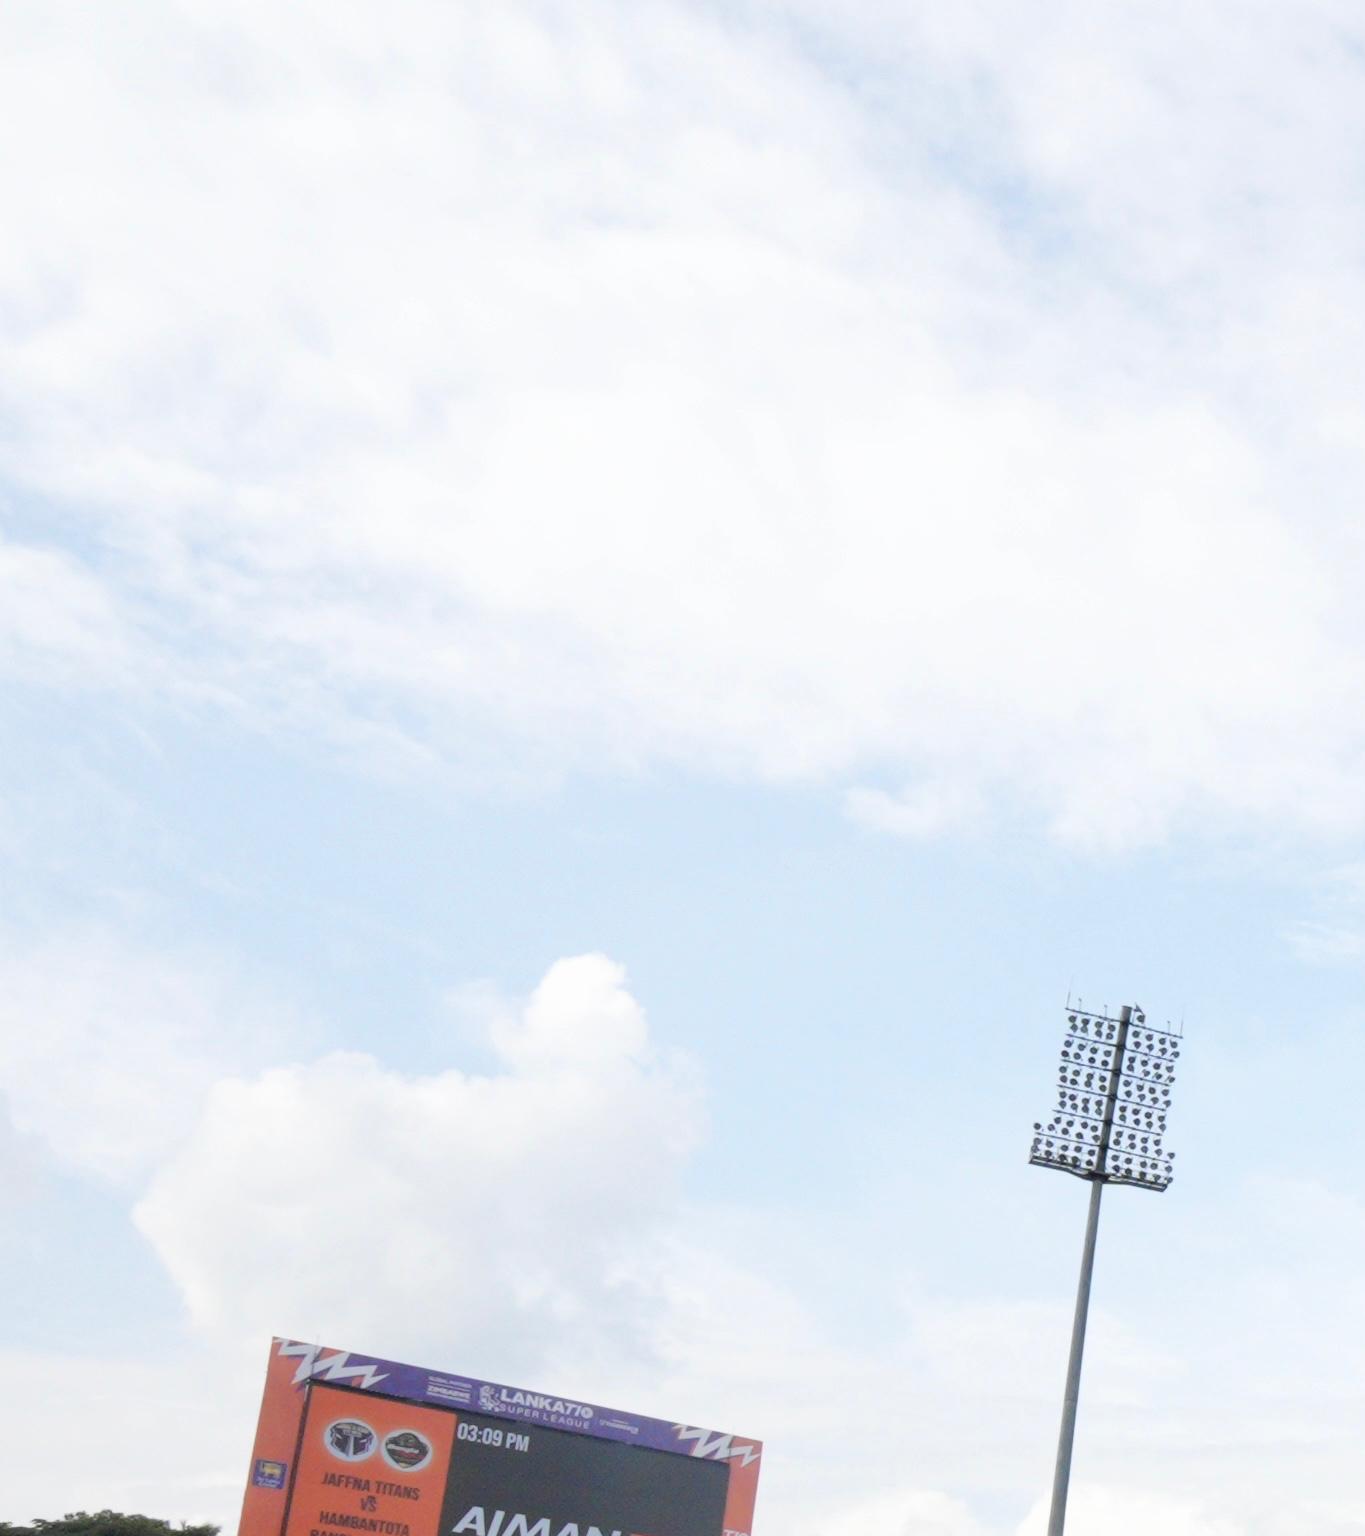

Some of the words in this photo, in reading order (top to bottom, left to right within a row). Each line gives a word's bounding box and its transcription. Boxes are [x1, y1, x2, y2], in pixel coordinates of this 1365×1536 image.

[499, 1403, 544, 1418] SUPER
[543, 1411, 591, 1430] LEAGUE
[457, 1422, 502, 1446] 03:09
[505, 1432, 530, 1452] PM
[321, 1472, 371, 1492] JAFFNA
[375, 1481, 420, 1501] TITANS
